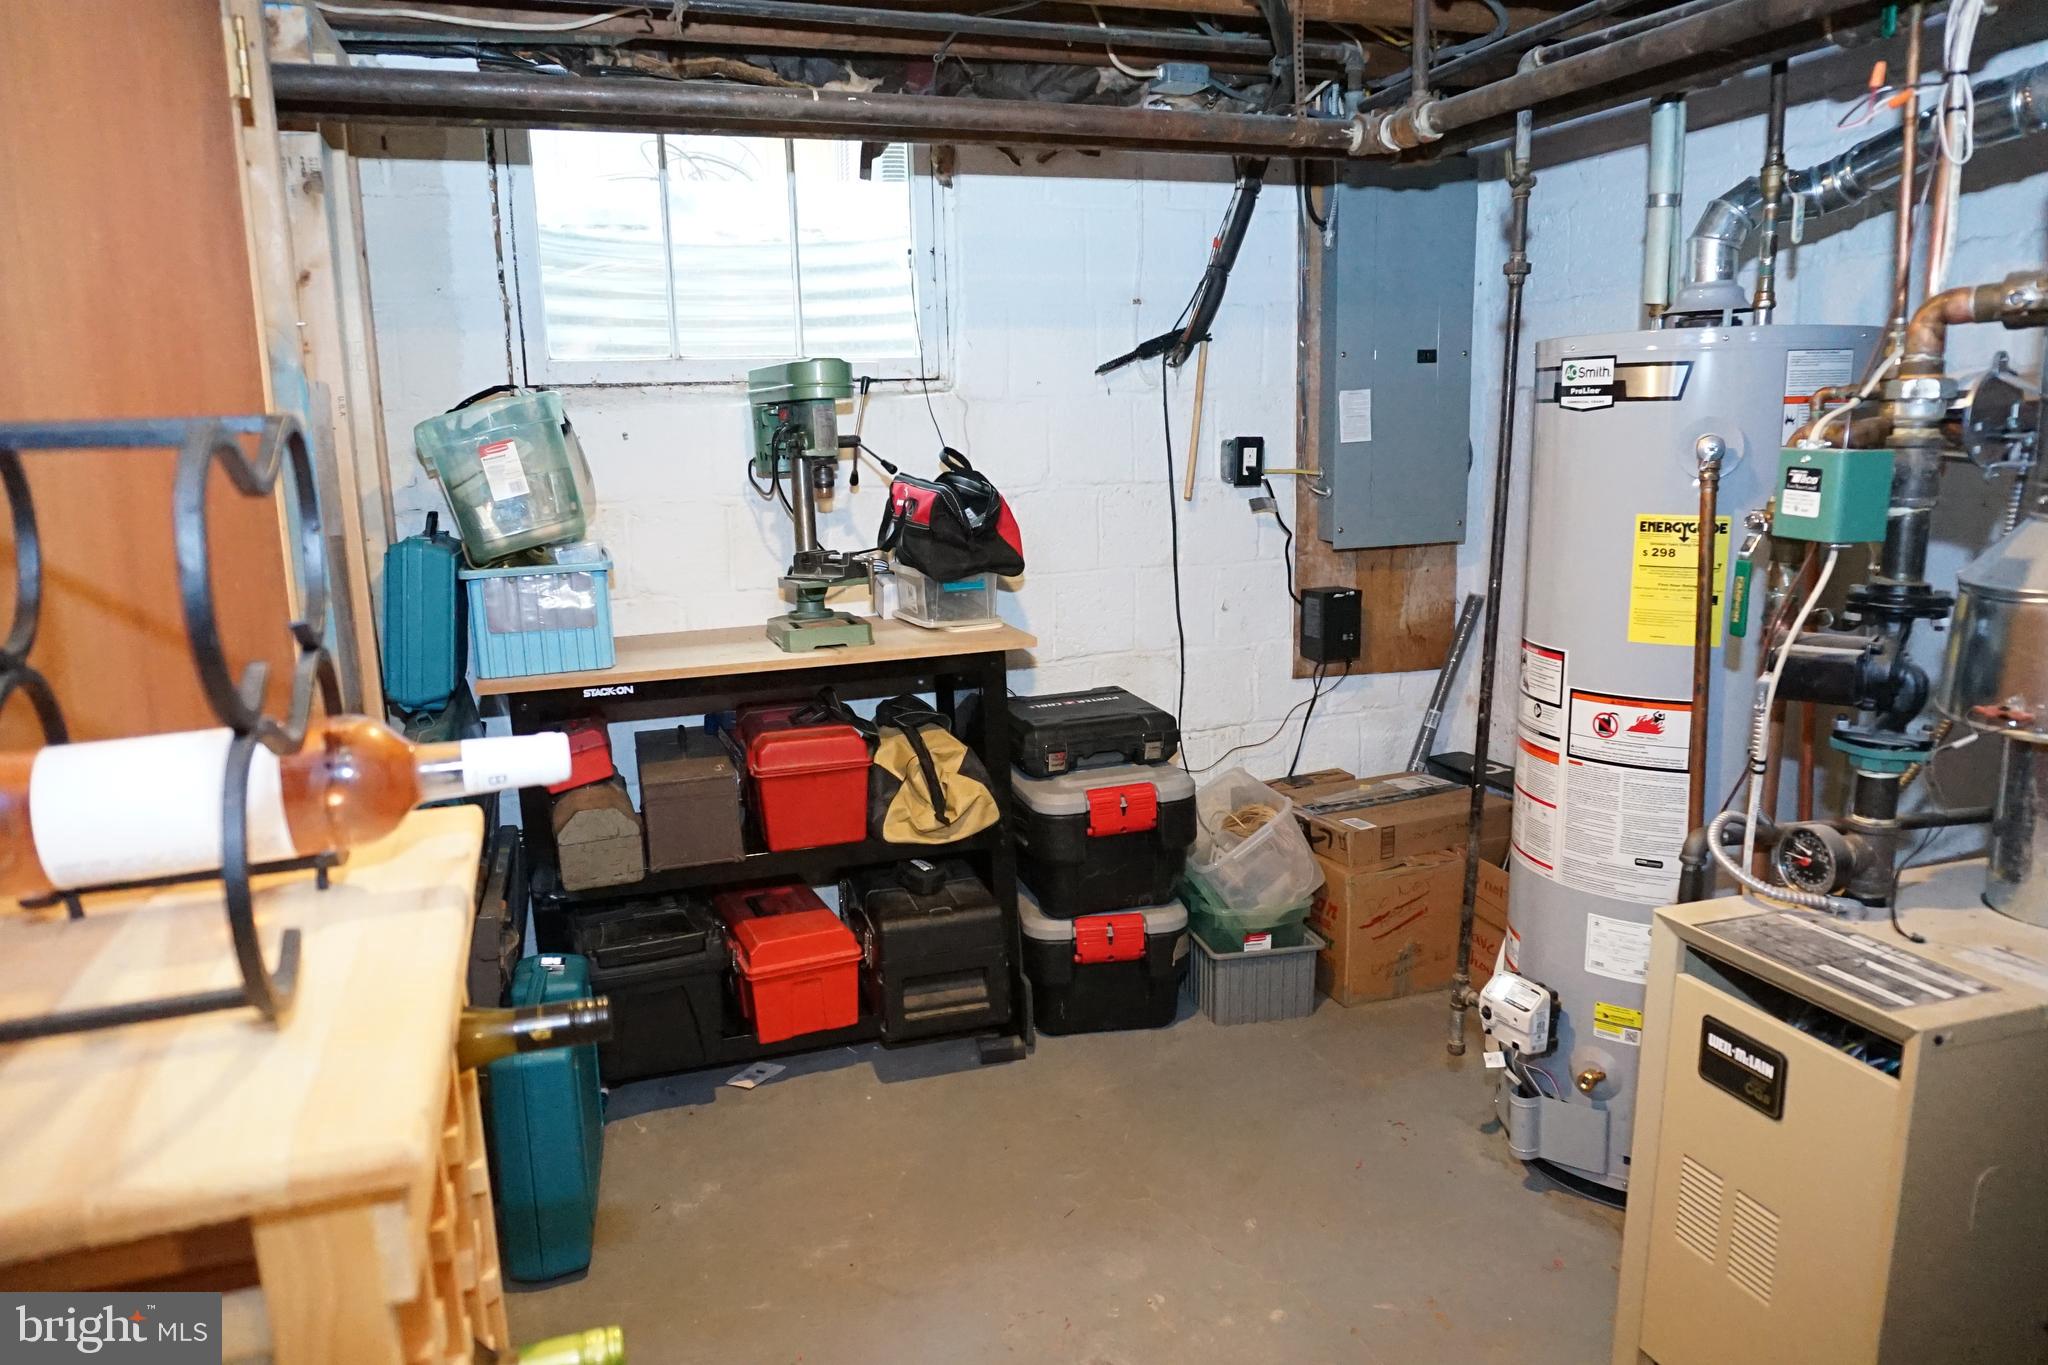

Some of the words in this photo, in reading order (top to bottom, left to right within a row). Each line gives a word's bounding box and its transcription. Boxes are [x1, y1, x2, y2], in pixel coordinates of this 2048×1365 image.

[1570, 387, 1602, 395] ProLine
[1651, 547, 1676, 558] 298
[583, 685, 635, 698] STACK-ON
